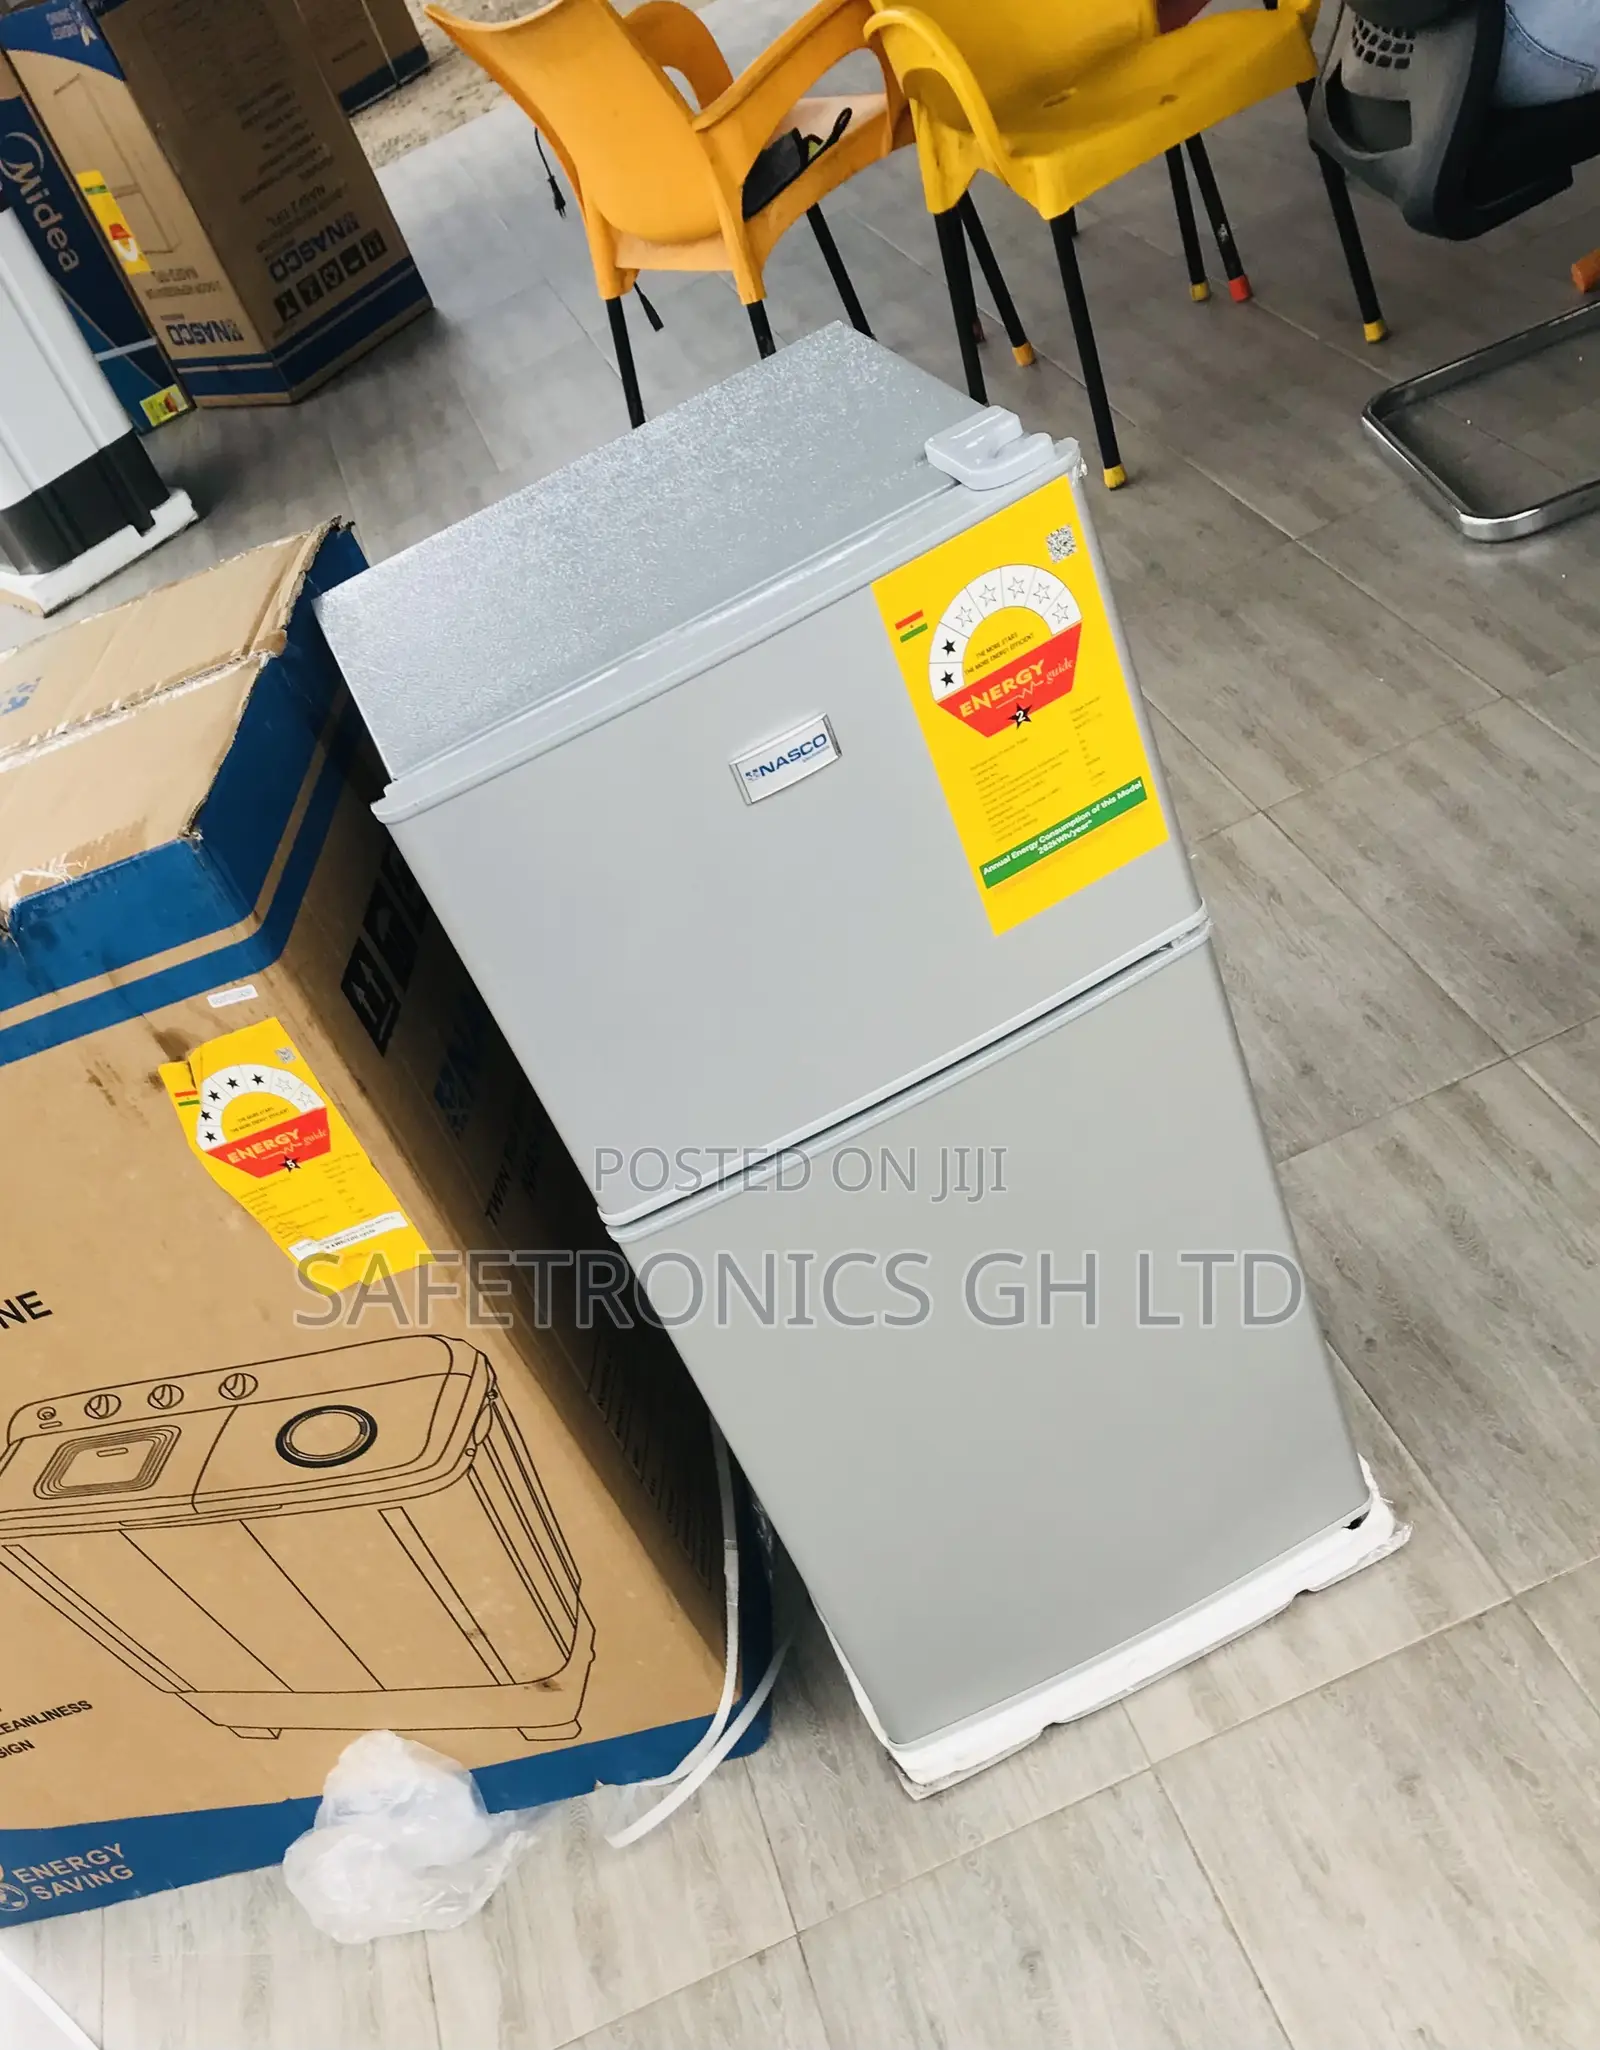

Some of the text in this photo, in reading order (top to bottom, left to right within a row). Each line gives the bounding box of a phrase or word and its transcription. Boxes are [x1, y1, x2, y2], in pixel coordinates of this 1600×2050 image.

[0, 158, 79, 272] Midea
[268, 223, 350, 283] NASCO
[166, 319, 229, 346] NASCO
[975, 657, 990, 669] MORE
[1010, 632, 1035, 650] EFFICIENT
[986, 642, 1001, 653] MORE
[960, 657, 1073, 718] ENERGY guide
[1016, 710, 1026, 722] 2
[758, 733, 827, 777] NASCO
[983, 780, 1143, 876] Annual Energy Consumption of this Model
[227, 1128, 327, 1164] ENERGY guide
[286, 1160, 296, 1169] 5
[12, 1842, 125, 1884] ENERGY
[31, 1864, 134, 1901] SAVING
